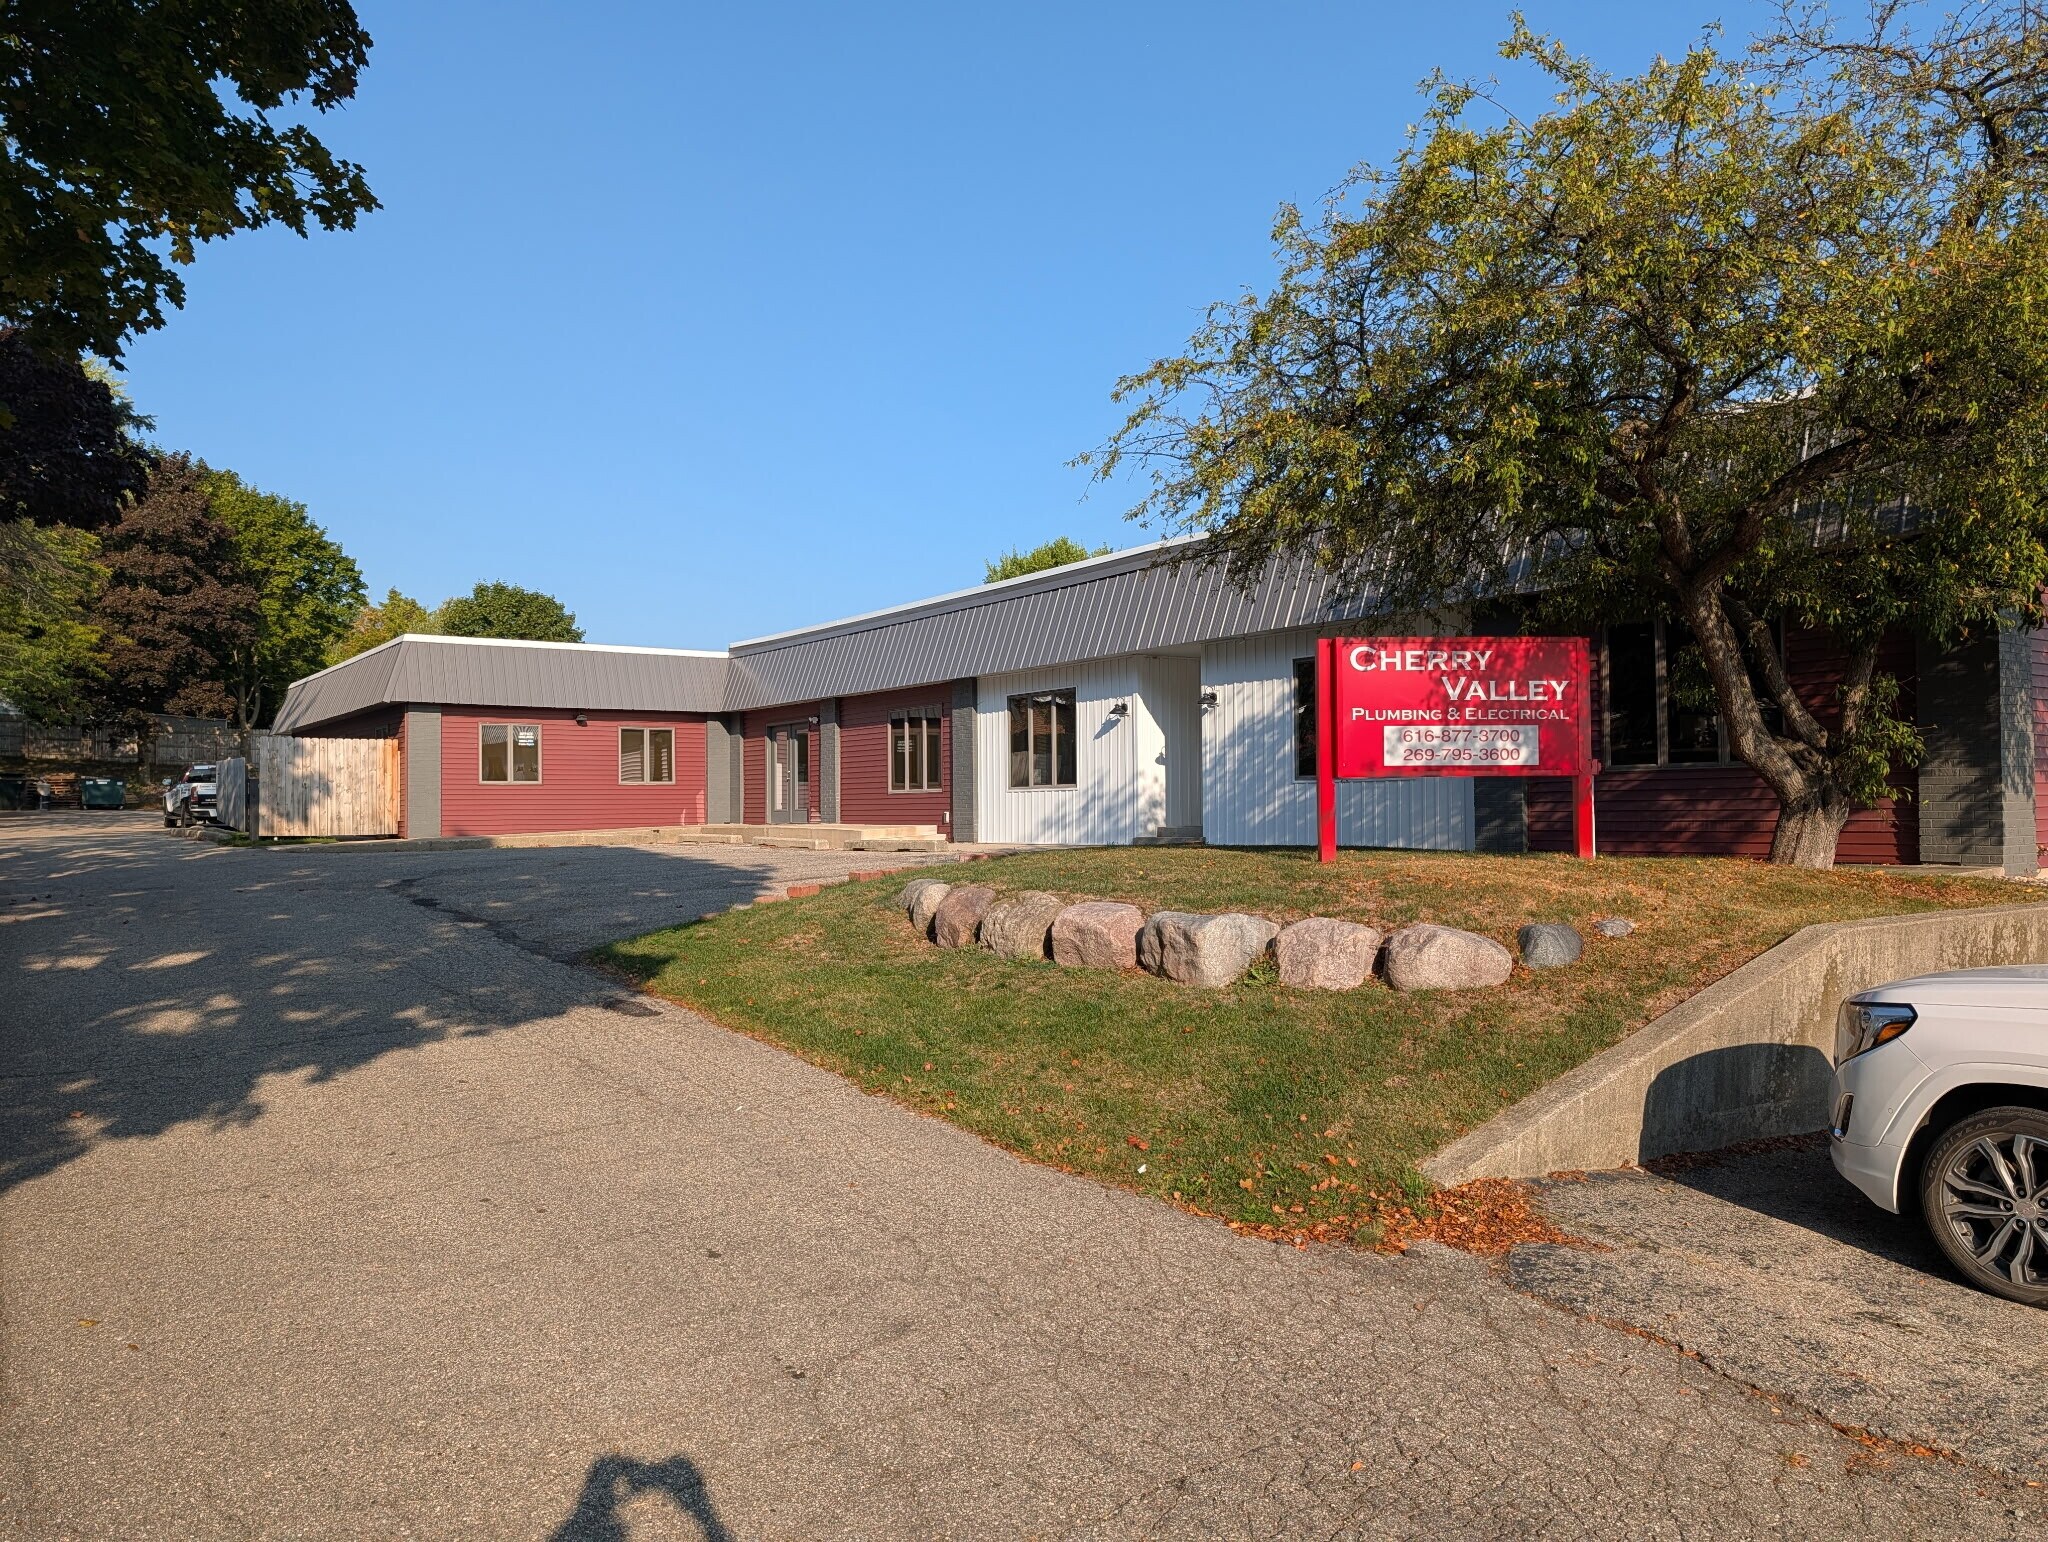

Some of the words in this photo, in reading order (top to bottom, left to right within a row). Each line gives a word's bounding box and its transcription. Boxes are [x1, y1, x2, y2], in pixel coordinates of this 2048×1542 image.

[1350, 646, 1493, 672] CHERRY
[1441, 676, 1570, 701] VALLEY
[1352, 707, 1442, 721] PLUMBING
[1447, 708, 1460, 720] &
[1465, 707, 1570, 720] ELECTRICAL
[1403, 729, 1520, 742] 616-877-3700
[1403, 748, 1520, 761] 269-795-3600
